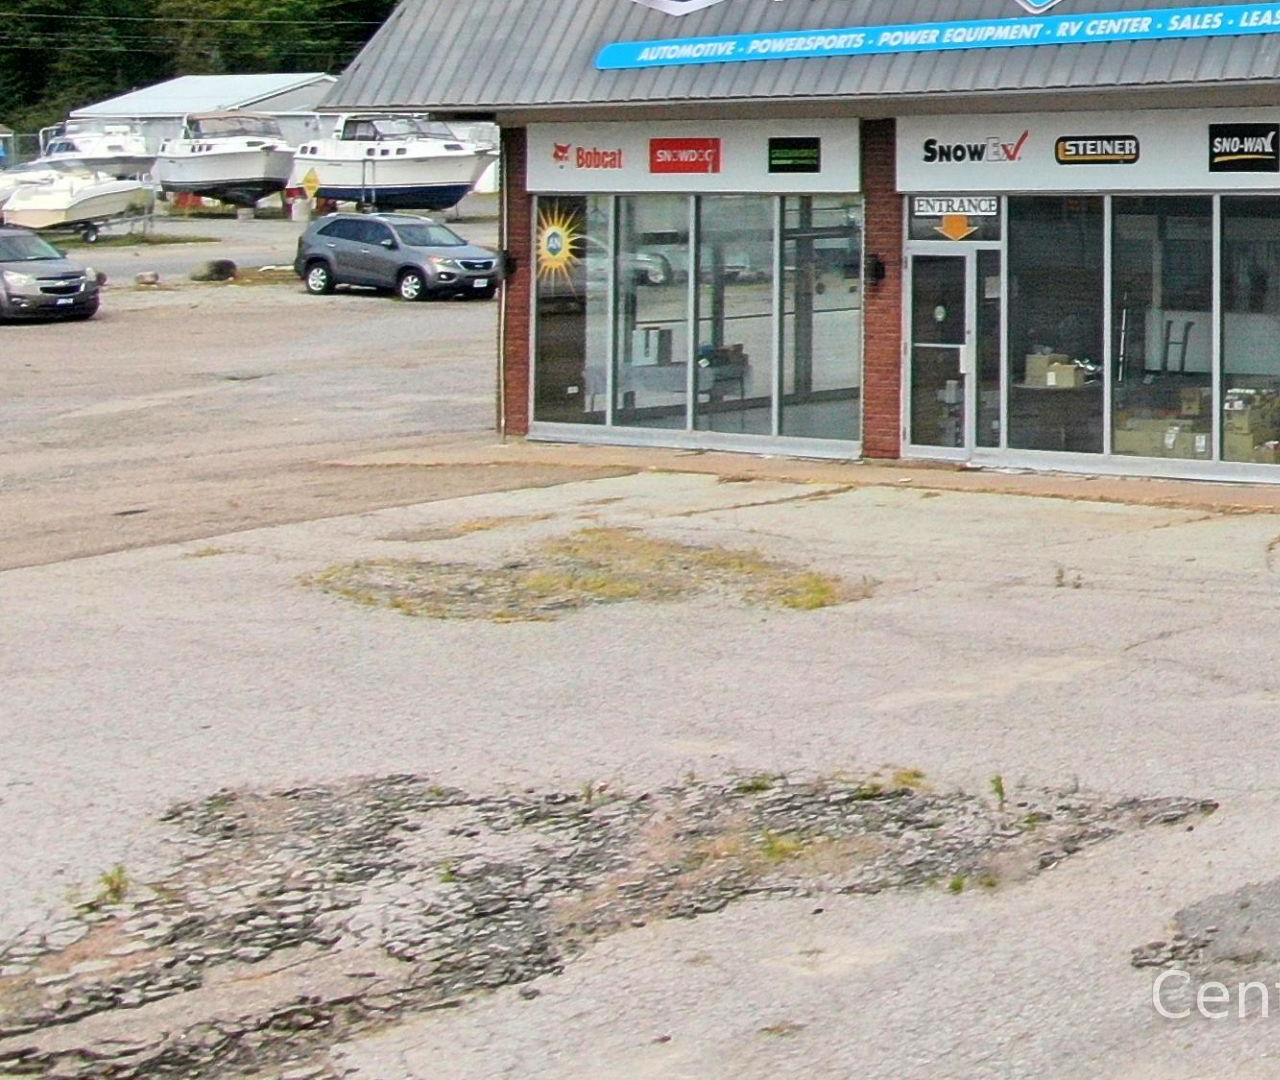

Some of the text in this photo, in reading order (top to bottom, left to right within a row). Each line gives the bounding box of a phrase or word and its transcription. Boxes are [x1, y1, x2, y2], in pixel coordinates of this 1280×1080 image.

[637, 41, 737, 62] AUTOMOTIVE
[748, 33, 866, 54] POWERSPORTS
[878, 29, 938, 47] POWER
[942, 23, 1044, 44] EQUIPMENT
[1056, 21, 1083, 38] RV
[1086, 17, 1153, 34] CENTER
[1167, 12, 1223, 32] SALES
[1064, 138, 1137, 155] STEINER
[1212, 131, 1275, 153] SNO-WAY
[575, 146, 623, 169] Bobcat
[914, 197, 998, 213] ENTRANCE
